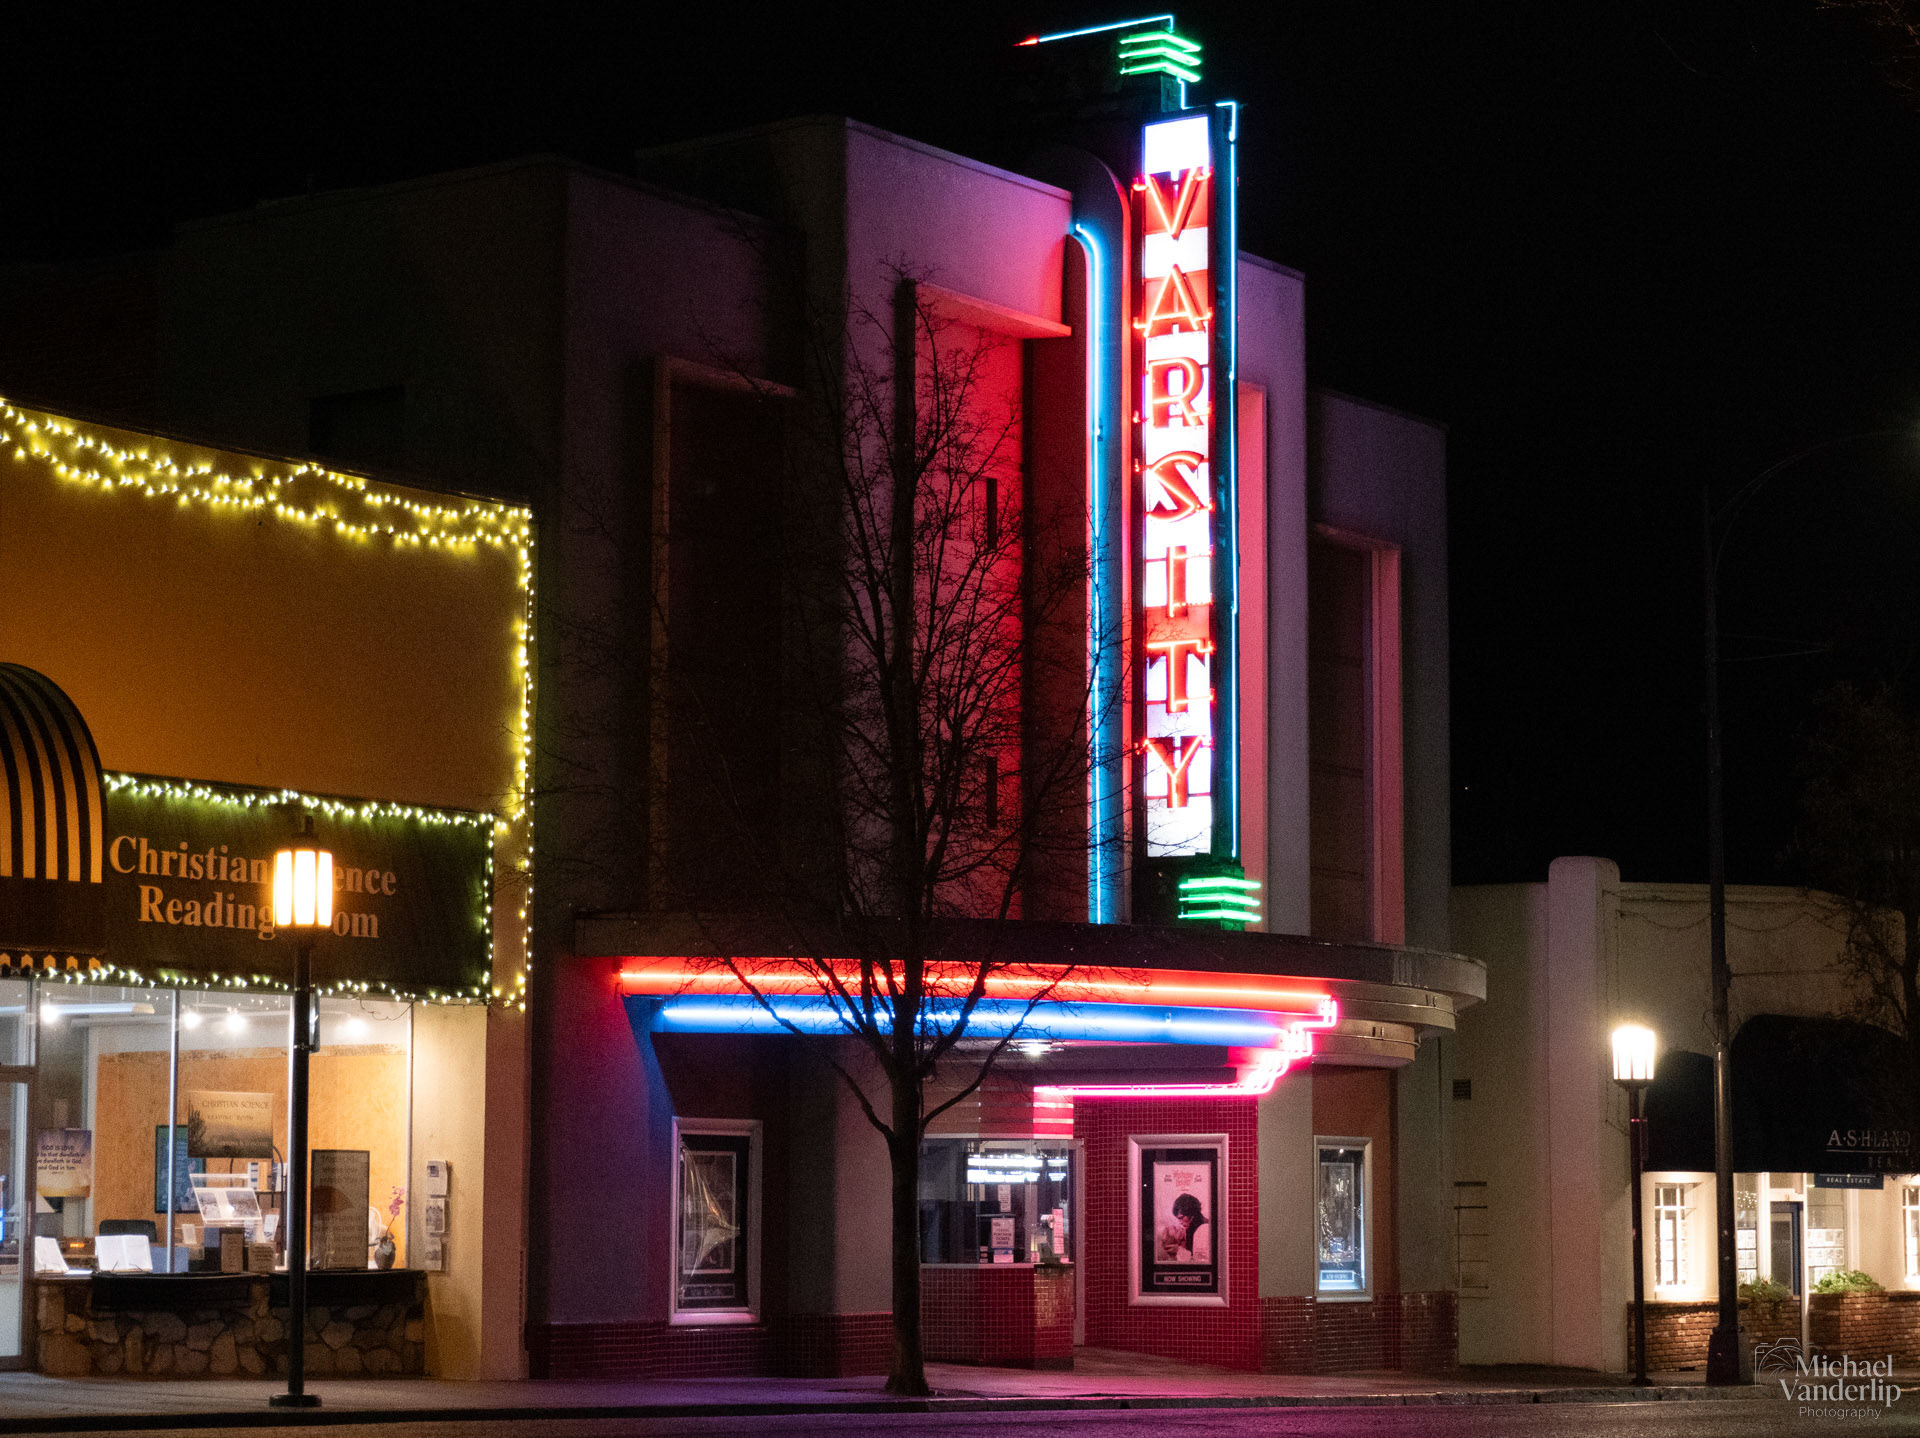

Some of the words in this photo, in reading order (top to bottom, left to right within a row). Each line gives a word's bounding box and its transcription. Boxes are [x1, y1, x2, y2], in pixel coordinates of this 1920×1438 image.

[1143, 166, 1208, 808] VARSITY
[109, 835, 275, 884] Christian
[138, 885, 276, 940] Reading
